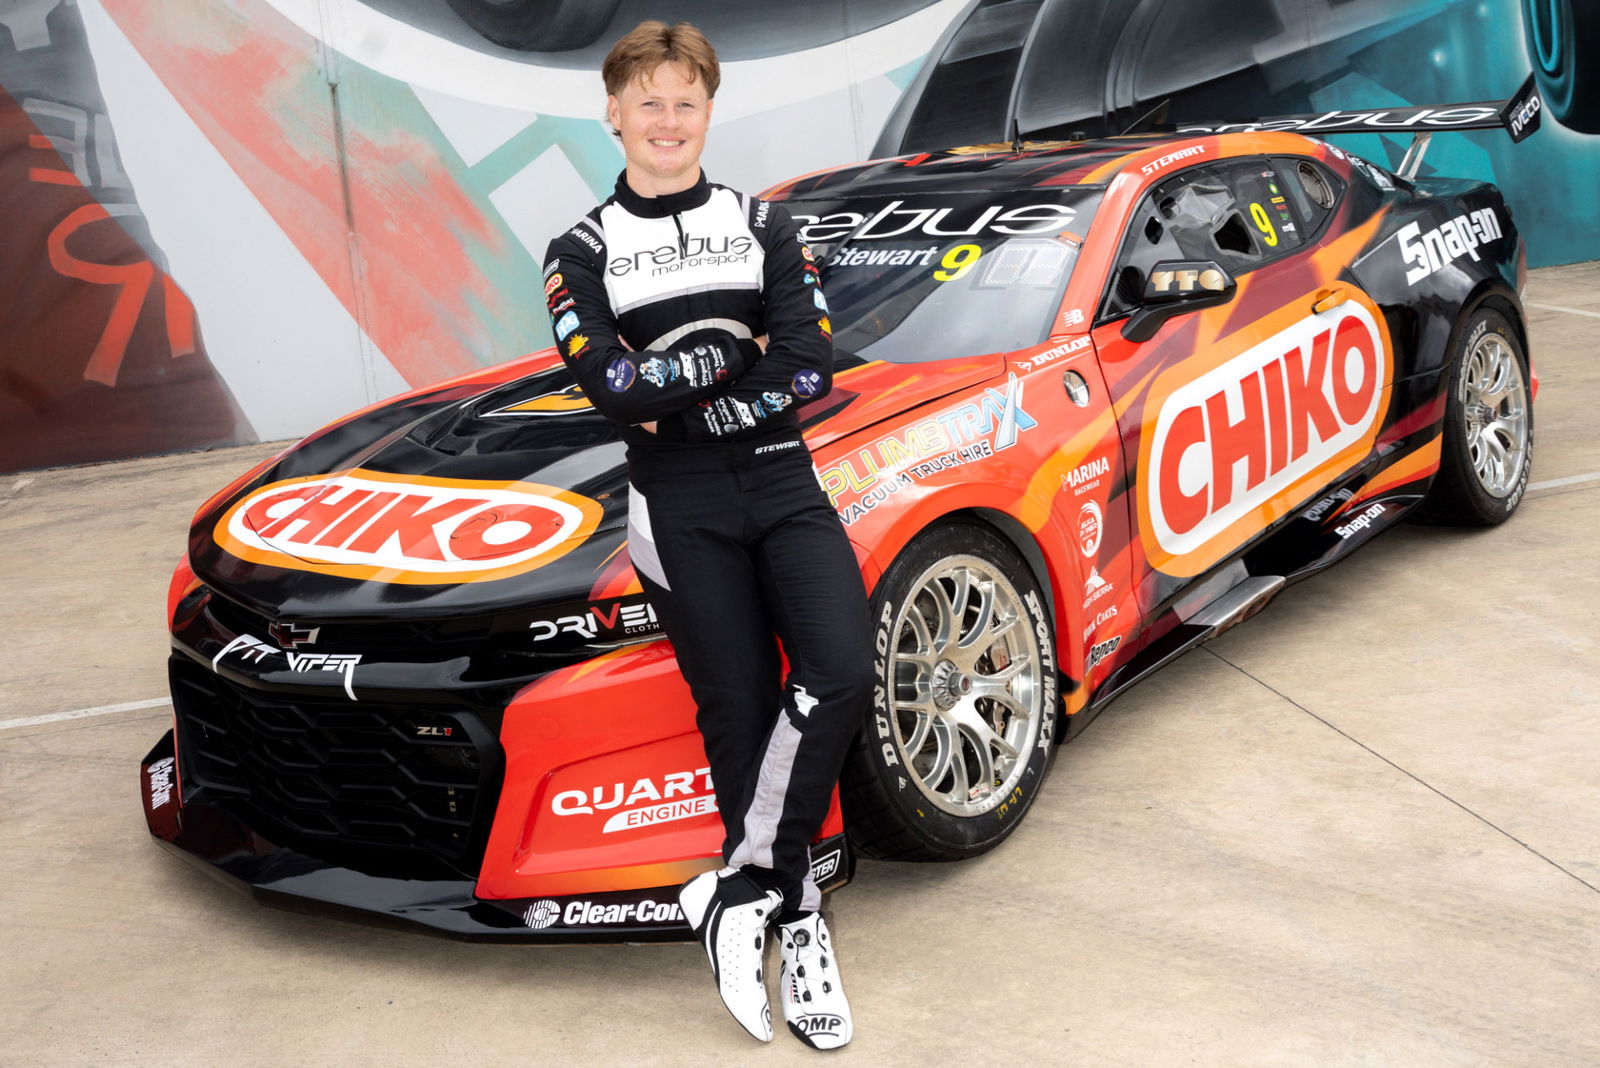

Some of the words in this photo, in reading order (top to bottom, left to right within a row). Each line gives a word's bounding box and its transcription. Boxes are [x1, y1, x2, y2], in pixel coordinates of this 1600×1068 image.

[1511, 96, 1540, 136] IVECO
[1141, 145, 1206, 176] STEWART
[1249, 203, 1278, 246] 9
[608, 233, 753, 277] erebus
[652, 254, 751, 277] motorsport
[829, 246, 938, 266] Stewart
[933, 244, 982, 282] 9
[1398, 207, 1503, 286] Snap-on
[1031, 336, 1091, 366] DUNLOP
[821, 372, 1037, 508] PLUMBTRAX
[1159, 315, 1377, 535] CHIKO
[755, 441, 801, 455] STEWART
[839, 472, 913, 525] VACUUM
[911, 454, 962, 480] TRUCK
[961, 441, 993, 463] HIRE
[1061, 456, 1110, 492] MARINA
[242, 485, 565, 562] CHIKO
[1334, 503, 1387, 540] Snap-on
[1024, 589, 1055, 673] SPORT
[212, 633, 282, 673] PIT
[286, 652, 363, 701] VIPER
[1085, 635, 1121, 676] Repco
[873, 601, 893, 767] DUNLOP
[417, 726, 452, 736] ZL1
[1037, 674, 1057, 756] MAXX
[627, 799, 706, 826] ENGINE
[797, 1017, 842, 1033] OMP
